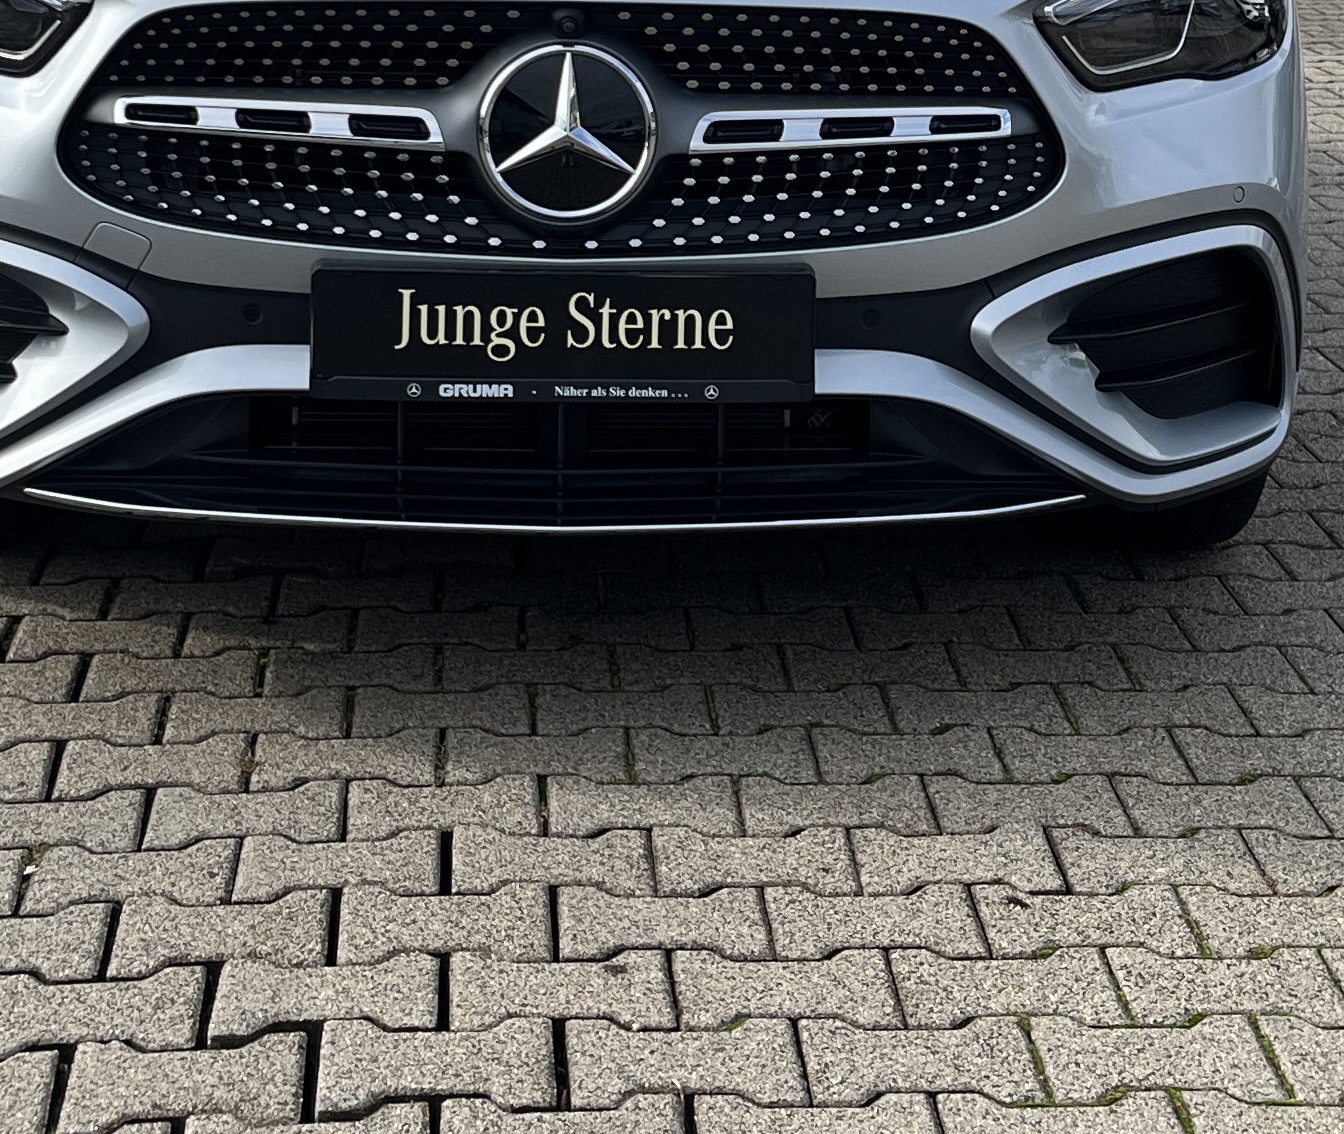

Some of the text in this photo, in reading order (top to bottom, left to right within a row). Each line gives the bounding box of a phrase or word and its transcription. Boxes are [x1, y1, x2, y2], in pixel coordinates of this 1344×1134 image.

[394, 288, 734, 362] Junge Sterne
[438, 384, 514, 398] GRUMA
[554, 385, 589, 398] Näher
[591, 386, 607, 398] als
[609, 386, 626, 398] Sie
